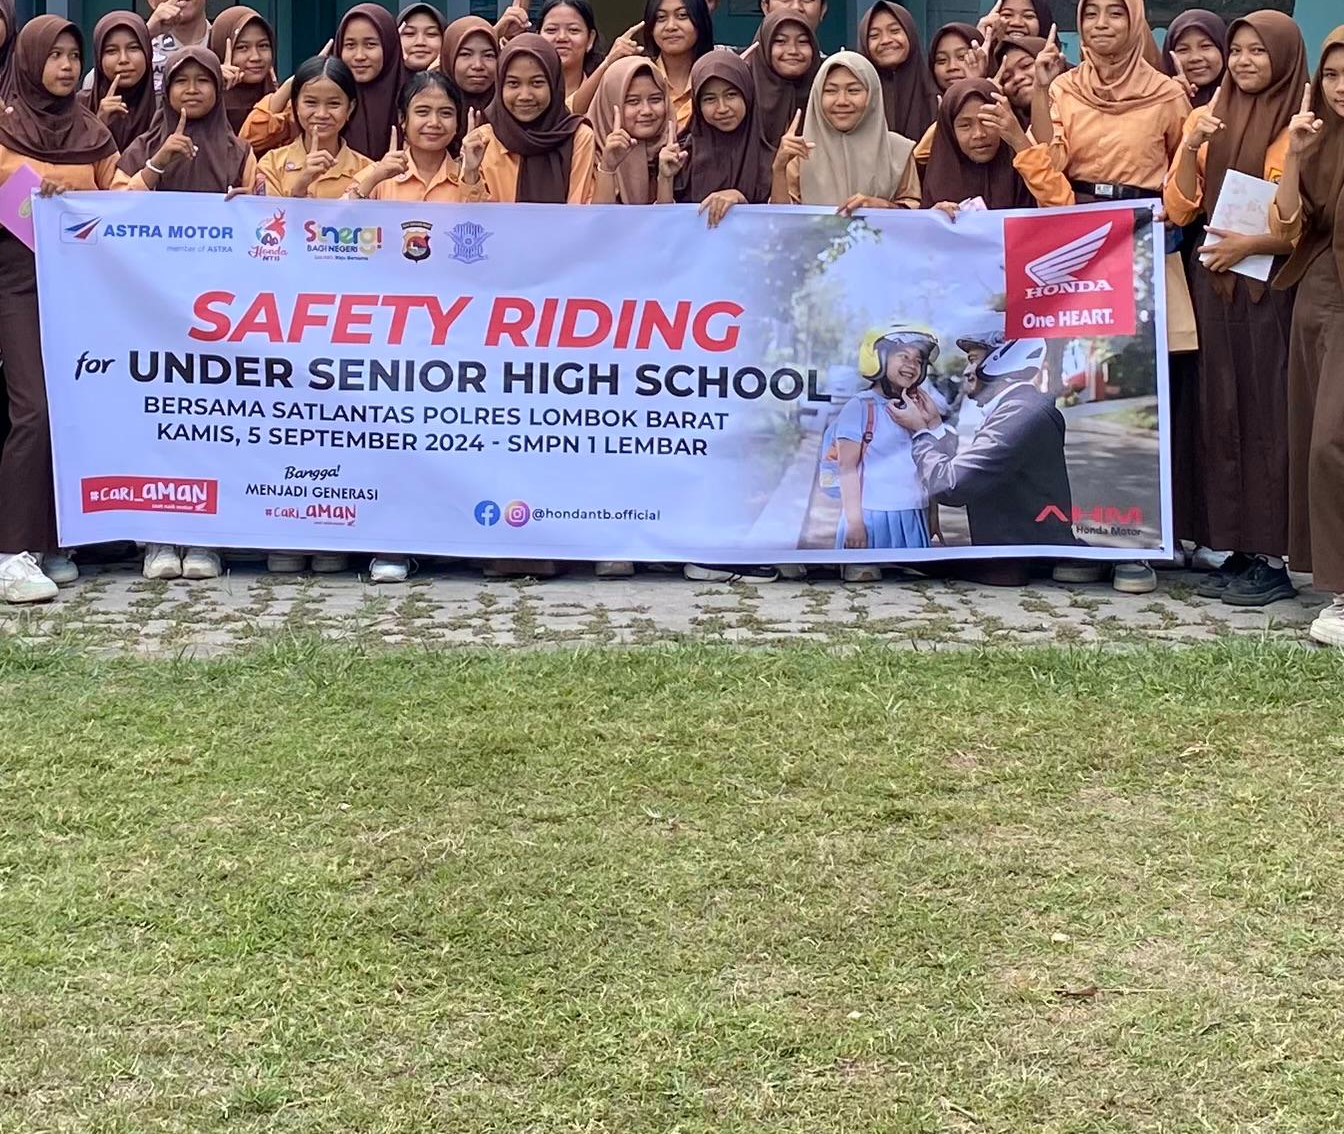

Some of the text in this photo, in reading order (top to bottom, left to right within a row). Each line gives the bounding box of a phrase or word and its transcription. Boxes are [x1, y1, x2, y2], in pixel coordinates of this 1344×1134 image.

[103, 224, 233, 239] ASTRA MOTOR
[1024, 279, 1113, 299] HONDA
[187, 290, 745, 353] SAFETY RIDING
[1023, 308, 1114, 329] One HEART.
[75, 350, 832, 403] for UNDER SENIOR HIGH SCHOOL
[144, 396, 729, 431] BERSAMA SATLANTAS POLRES LOMBOK BARAT
[157, 422, 241, 446] KAMIS,
[248, 427, 261, 444] 5
[269, 428, 418, 451] SEPTEMBER
[425, 433, 485, 452] 2024
[508, 435, 579, 454] SMPN
[588, 436, 596, 453] 1
[605, 436, 707, 455] LEMBAR
[284, 464, 341, 481] Bangga!
[245, 483, 378, 500] MENJADI GENERASI
[532, 508, 660, 521] @hondantb.official
[1076, 526, 1142, 536] Honda Motor
